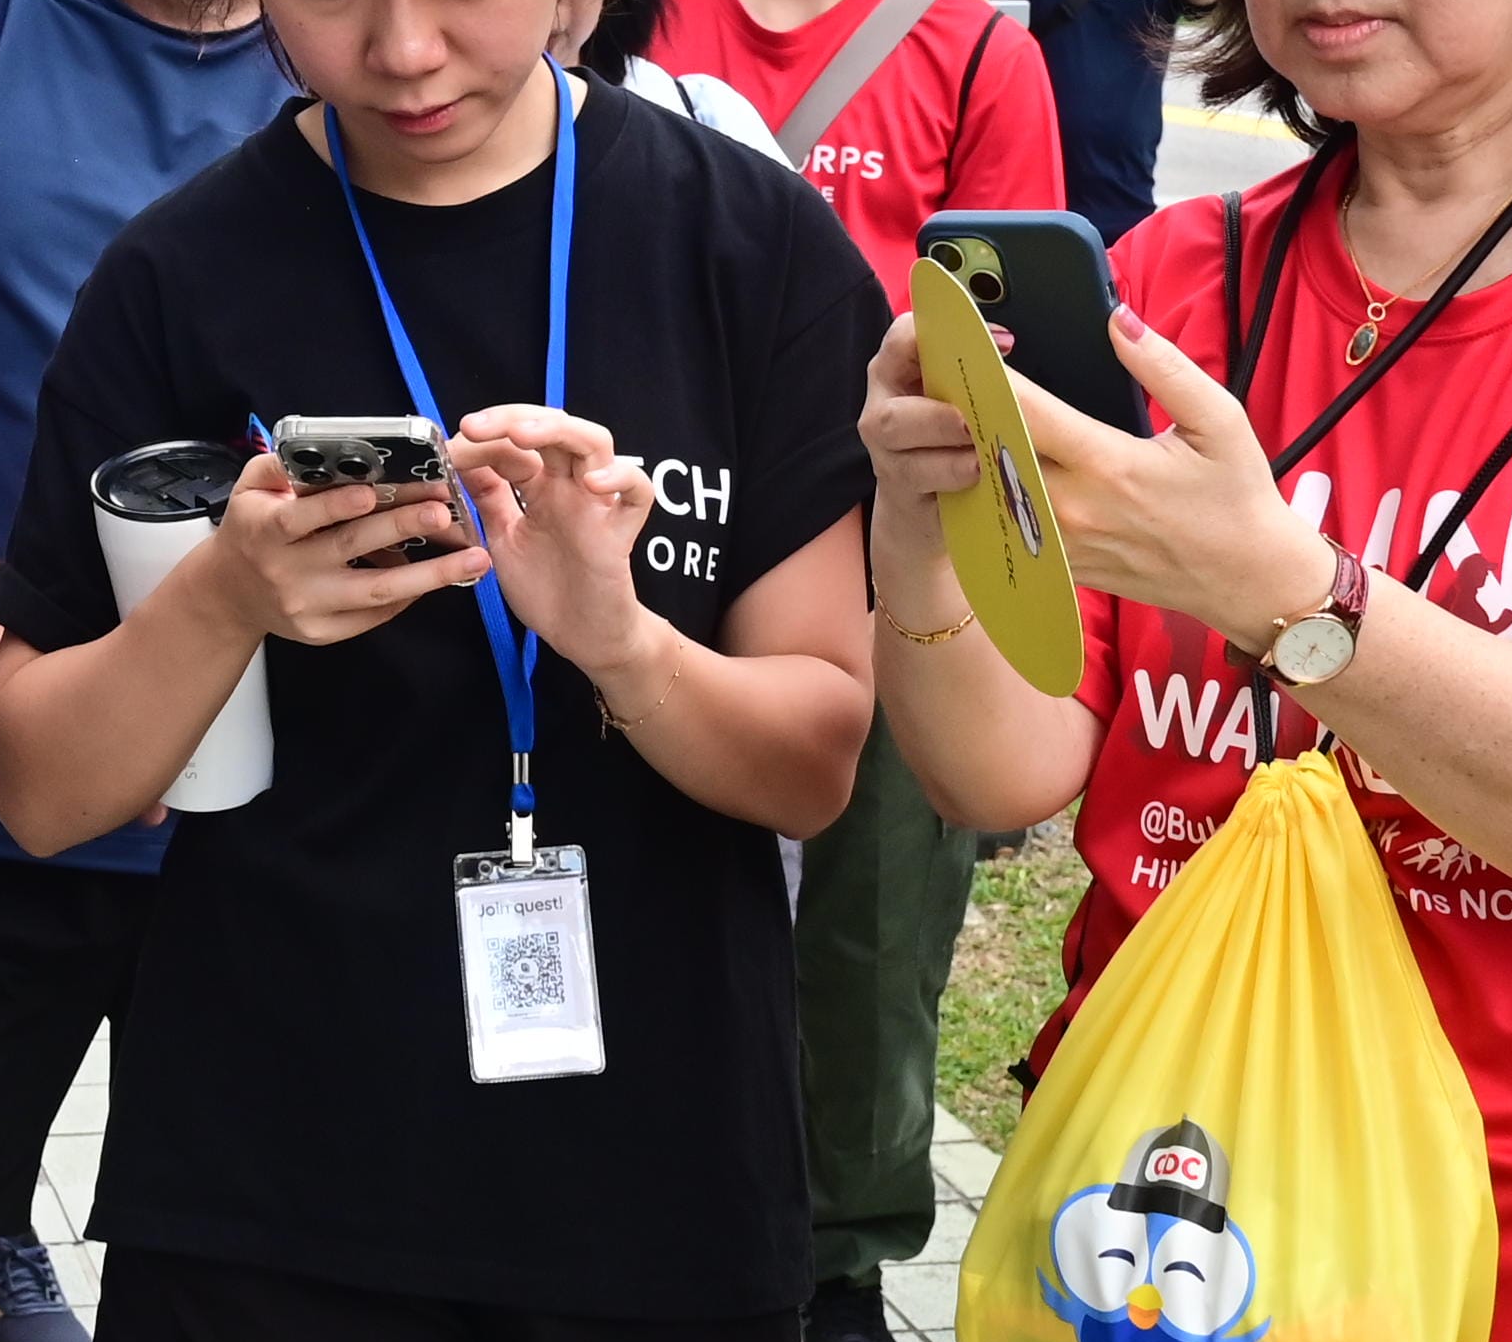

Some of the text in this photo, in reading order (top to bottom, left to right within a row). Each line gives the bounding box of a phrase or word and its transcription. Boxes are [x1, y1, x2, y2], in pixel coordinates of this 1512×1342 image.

[614, 455, 731, 524] CH
[513, 896, 564, 916] quest!
[1153, 1153, 1202, 1181] CDC
